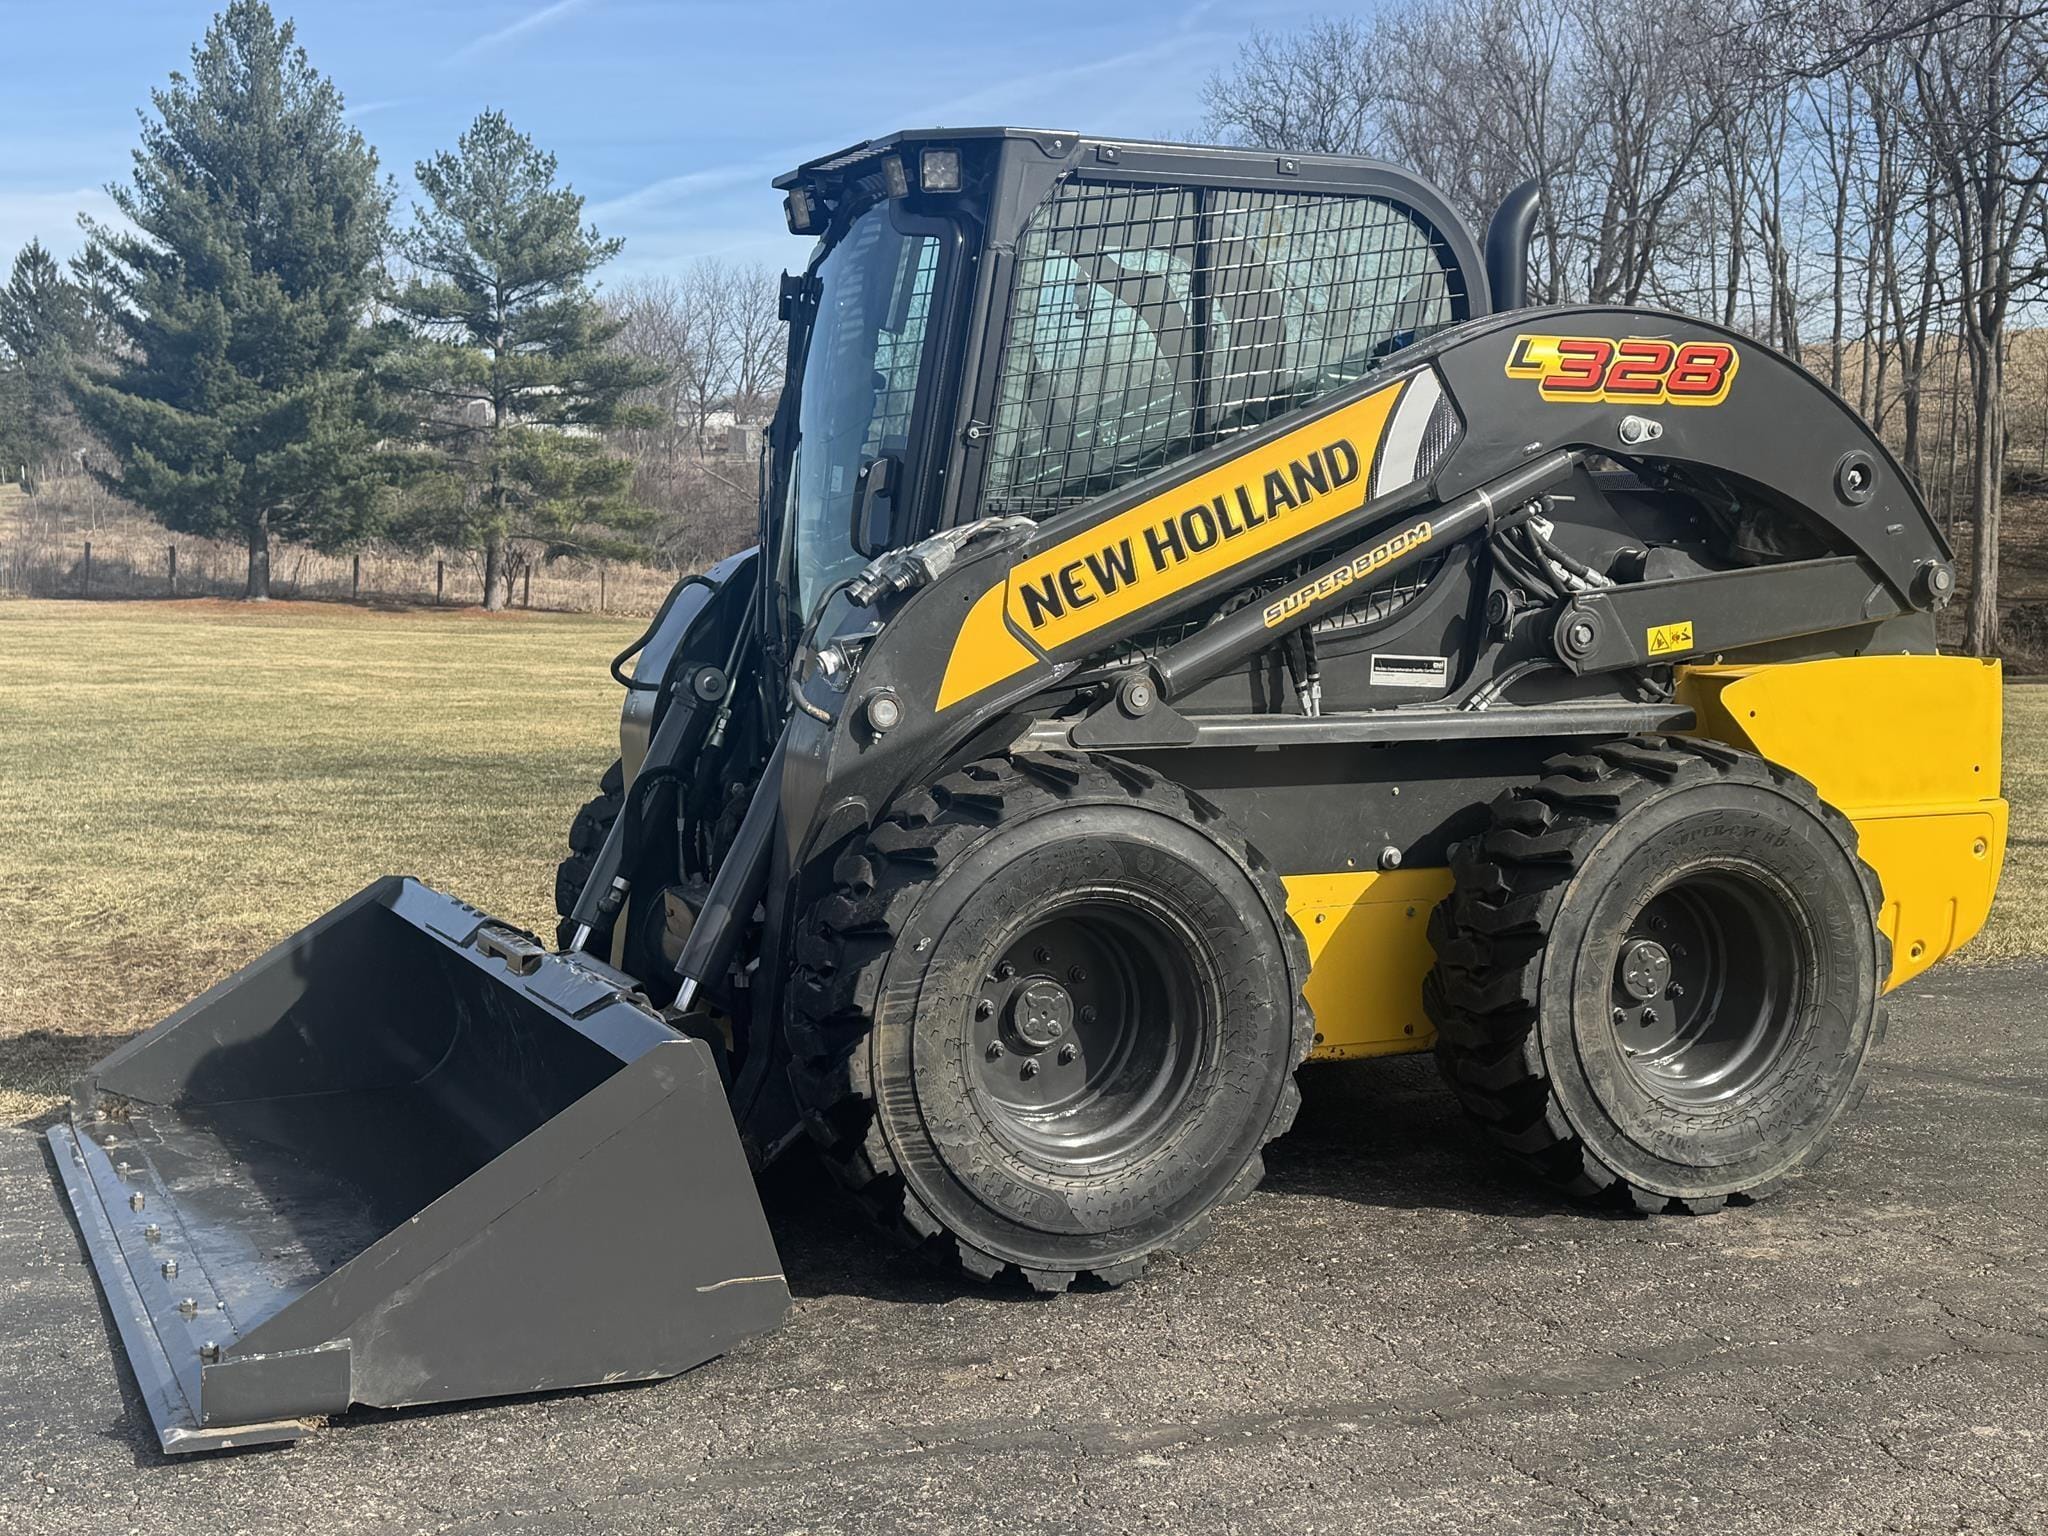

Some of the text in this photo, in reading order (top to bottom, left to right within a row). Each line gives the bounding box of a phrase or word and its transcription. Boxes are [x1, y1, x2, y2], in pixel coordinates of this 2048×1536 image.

[1505, 335, 1740, 406] L328
[1018, 437, 1362, 630] NEW HOLLAND
[1263, 521, 1432, 628] SUPER BOOM
